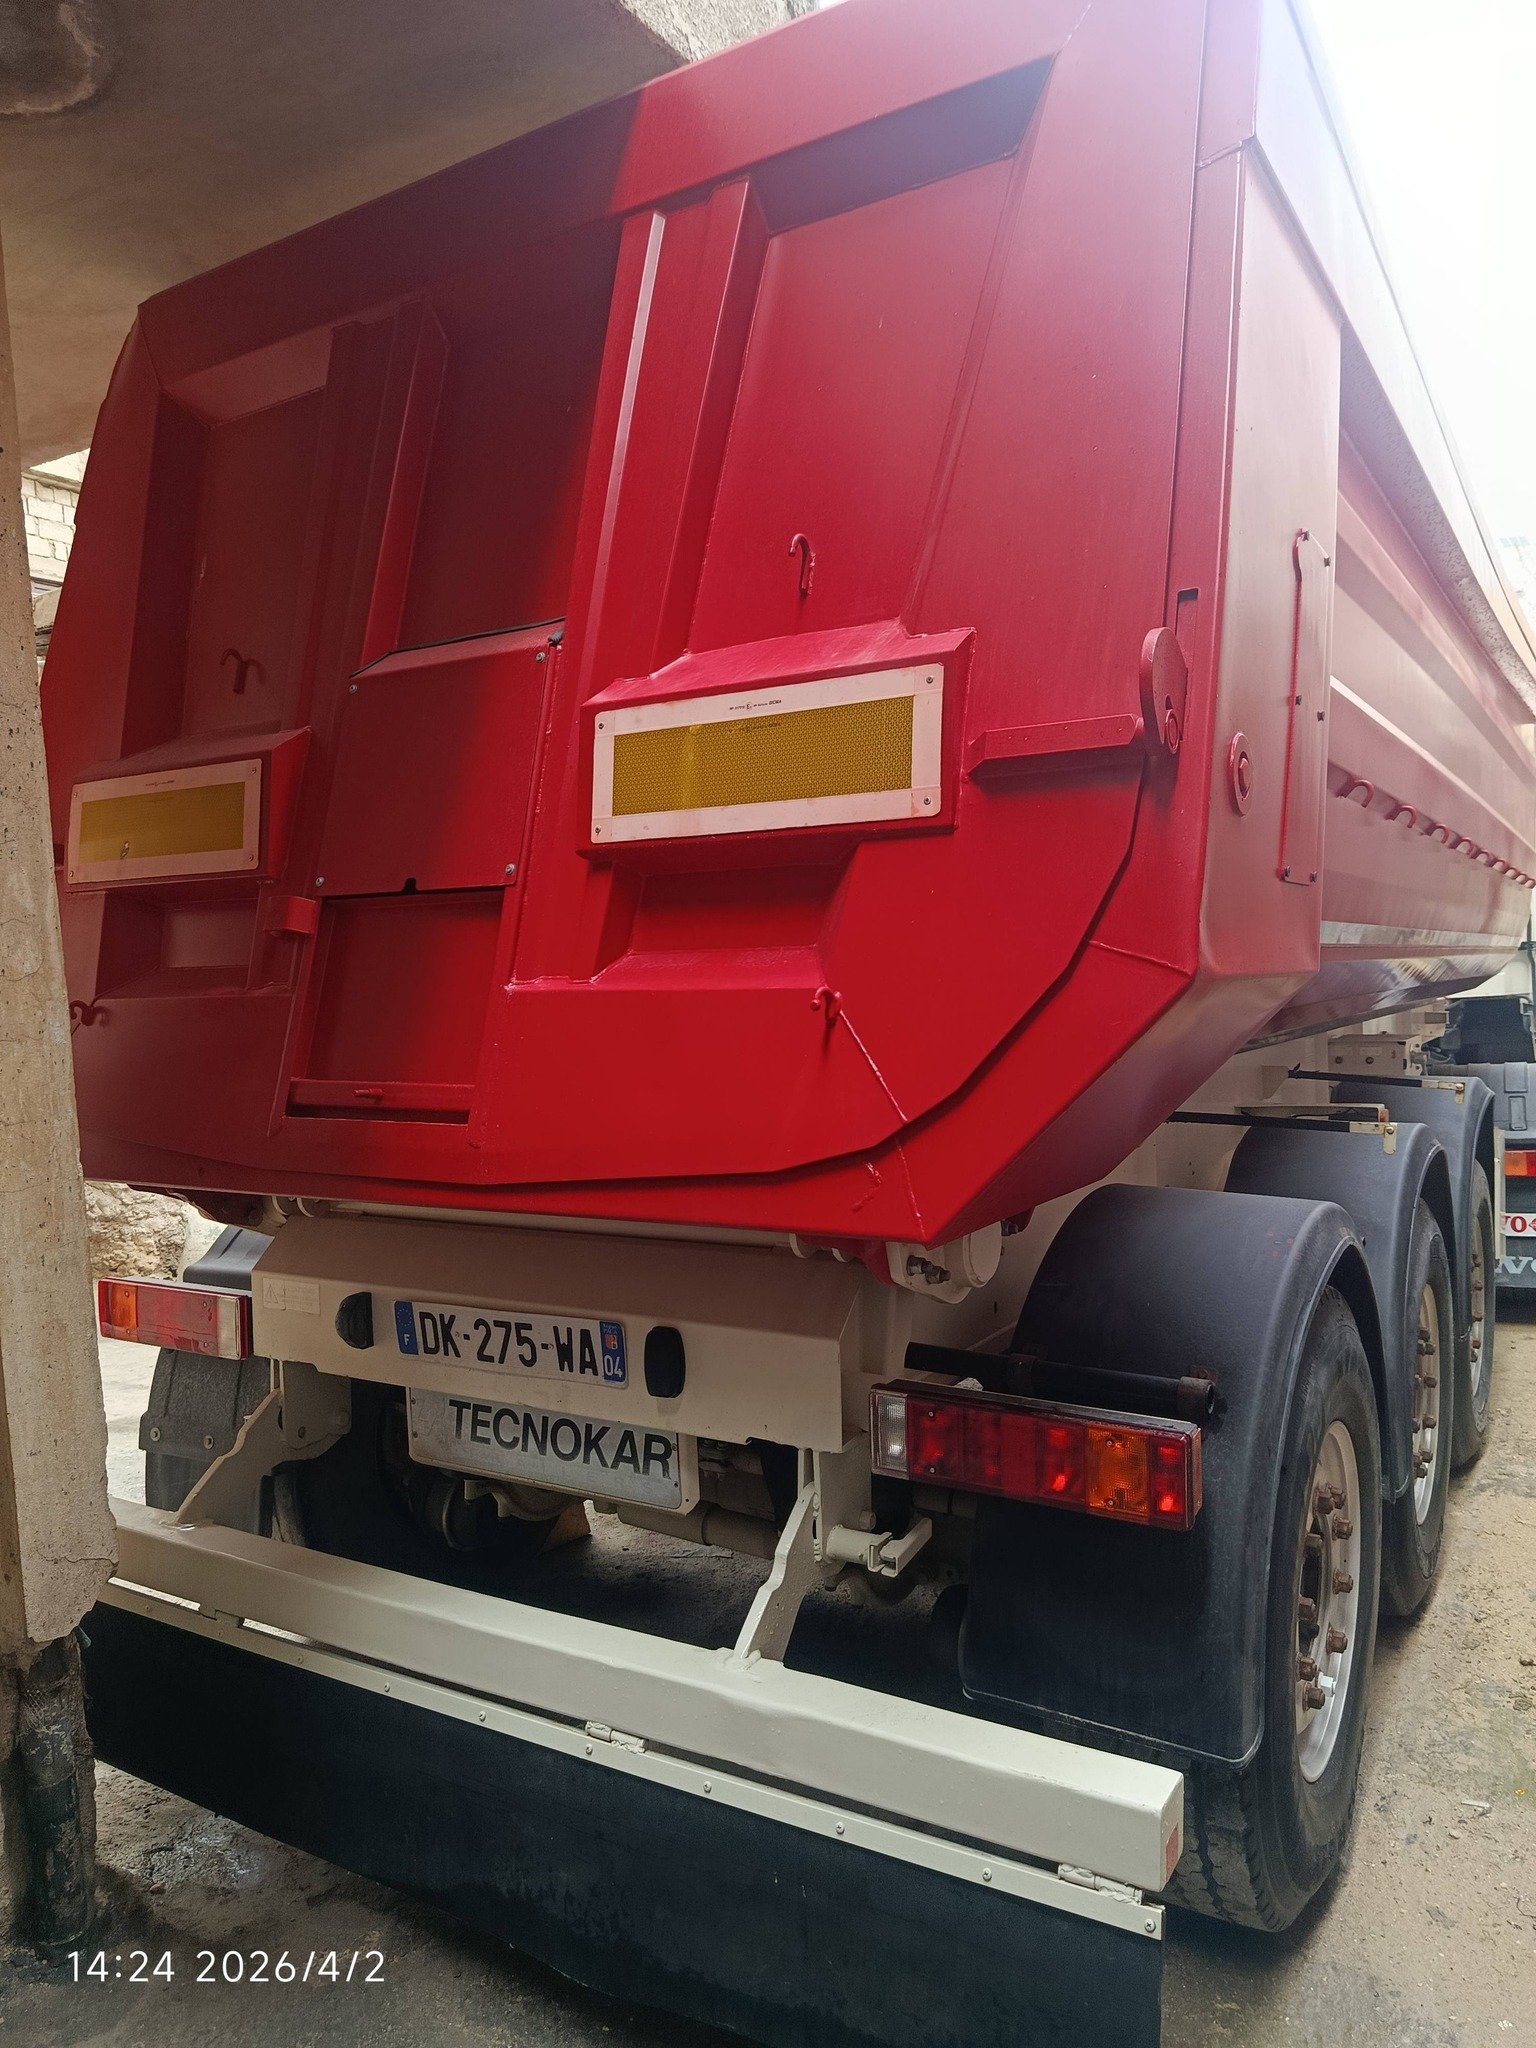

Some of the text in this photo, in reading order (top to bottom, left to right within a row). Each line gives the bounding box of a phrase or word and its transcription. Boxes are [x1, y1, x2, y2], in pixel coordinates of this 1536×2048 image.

[403, 1333, 410, 1346] F
[418, 1311, 599, 1377] DK-275-WA
[603, 1354, 624, 1378] 04
[448, 1398, 673, 1480] TECNOKAR
